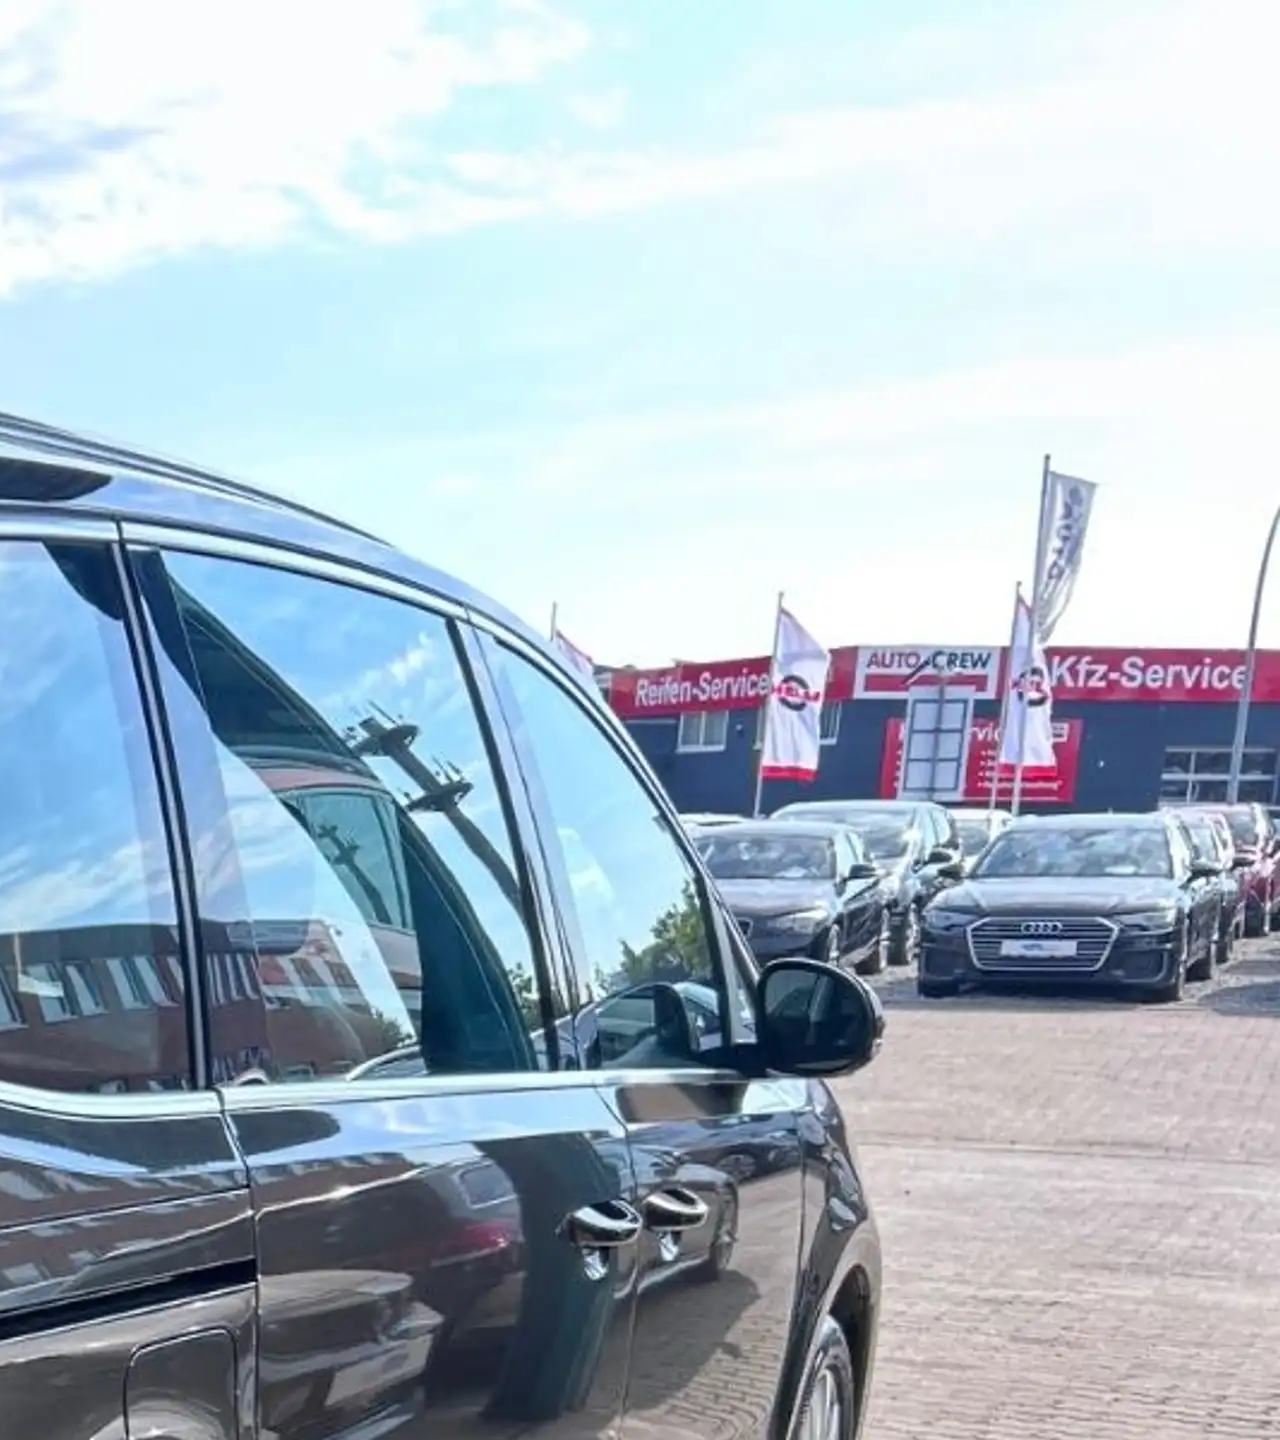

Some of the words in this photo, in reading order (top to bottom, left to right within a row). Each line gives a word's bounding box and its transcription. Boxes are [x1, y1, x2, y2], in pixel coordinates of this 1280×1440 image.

[866, 651, 920, 670] AUTO
[931, 651, 992, 669] CREW
[1048, 655, 1249, 690] Kfz-Service
[635, 668, 772, 707] Reifen-Service
